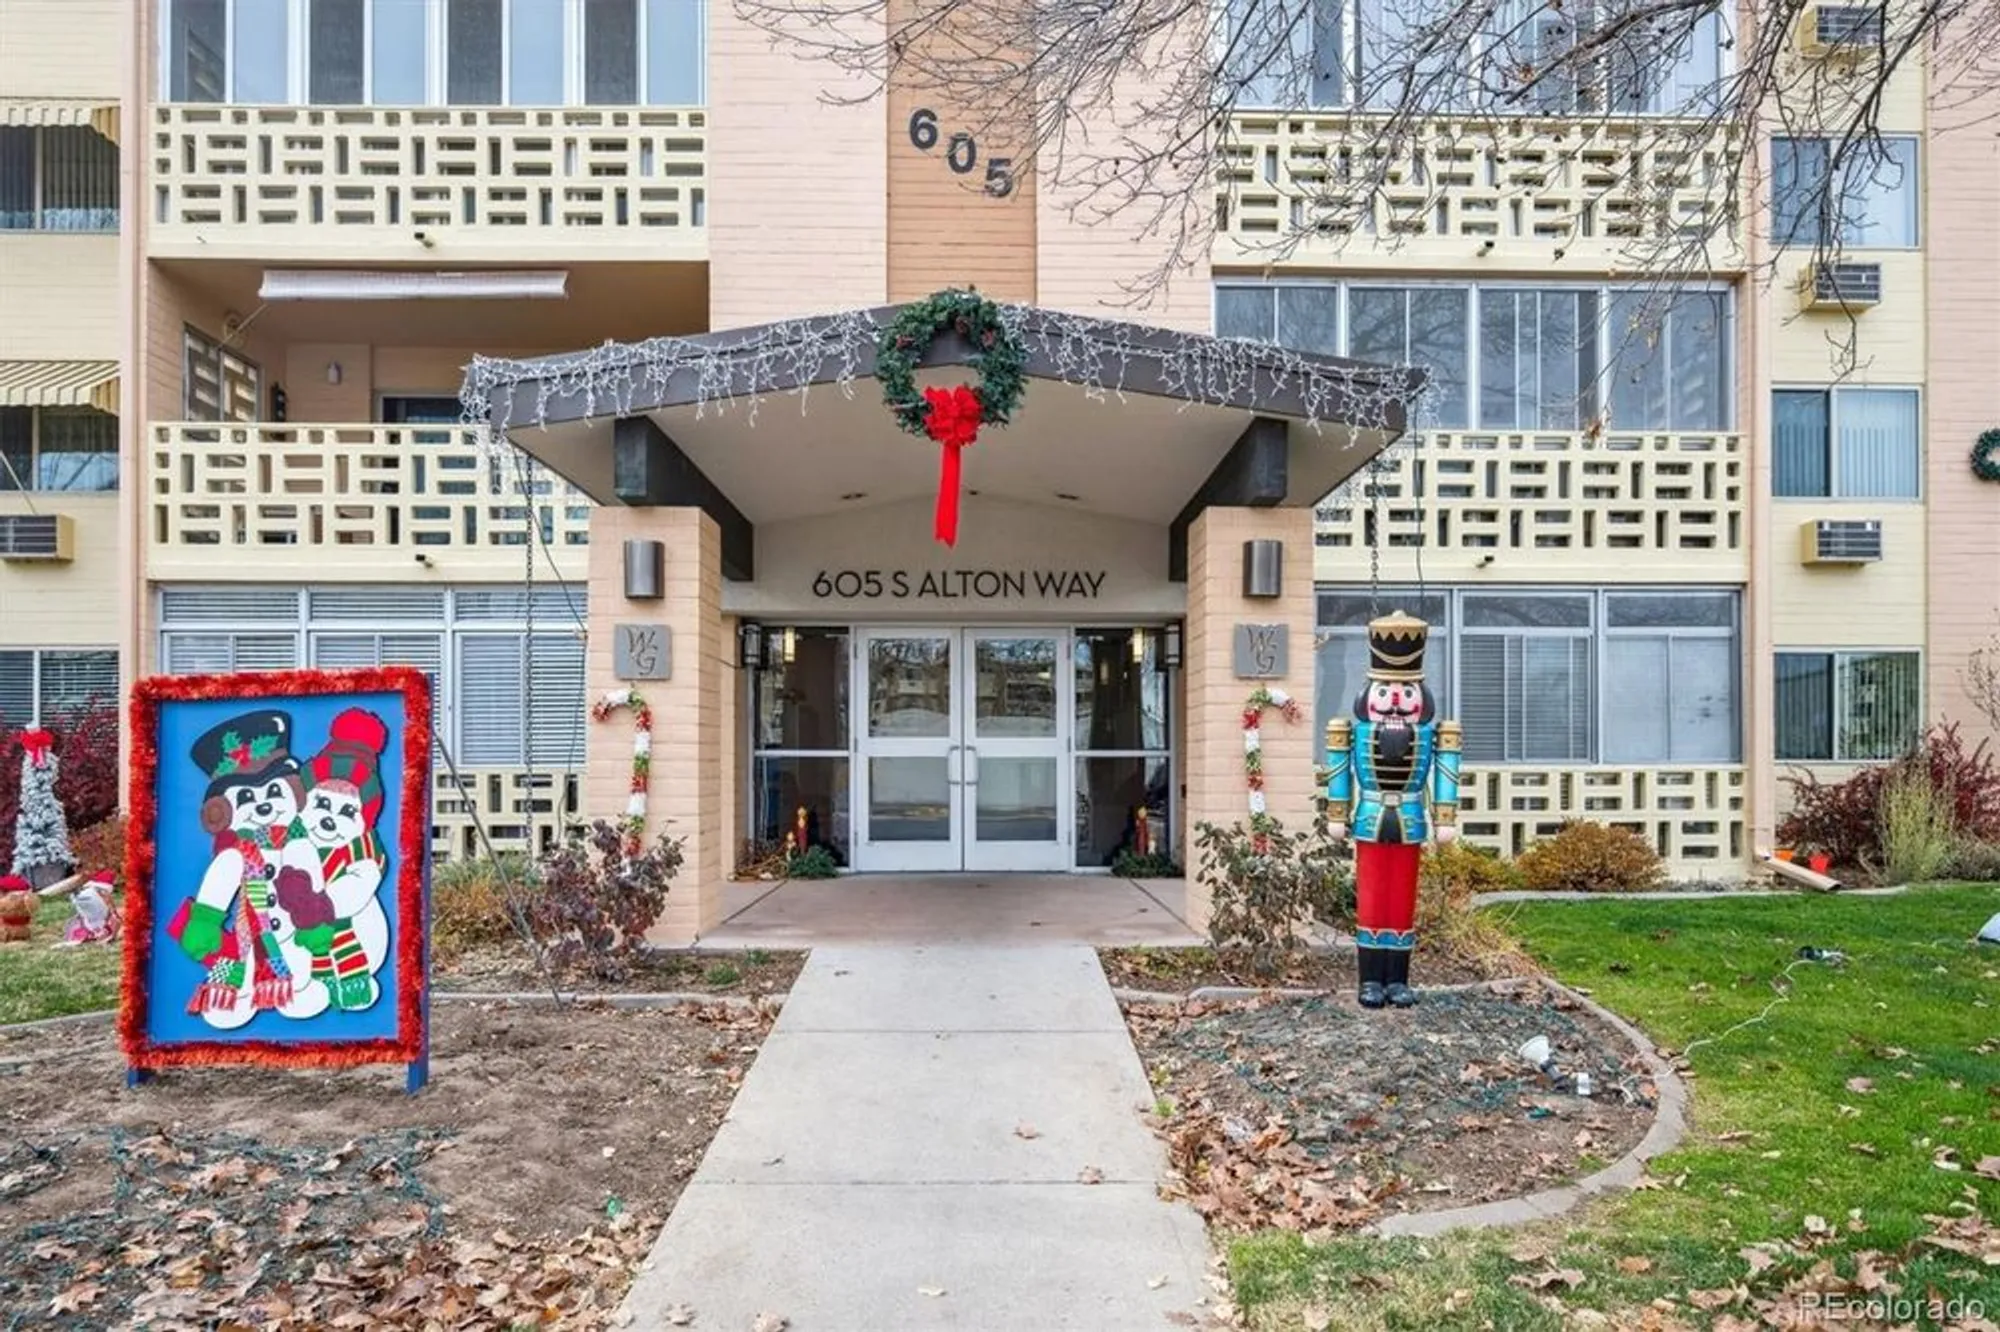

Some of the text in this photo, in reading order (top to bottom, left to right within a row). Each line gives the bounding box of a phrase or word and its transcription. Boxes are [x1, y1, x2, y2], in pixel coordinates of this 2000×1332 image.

[909, 108, 1013, 198] 605
[812, 570, 1106, 598] 605 S ALTON WAY
